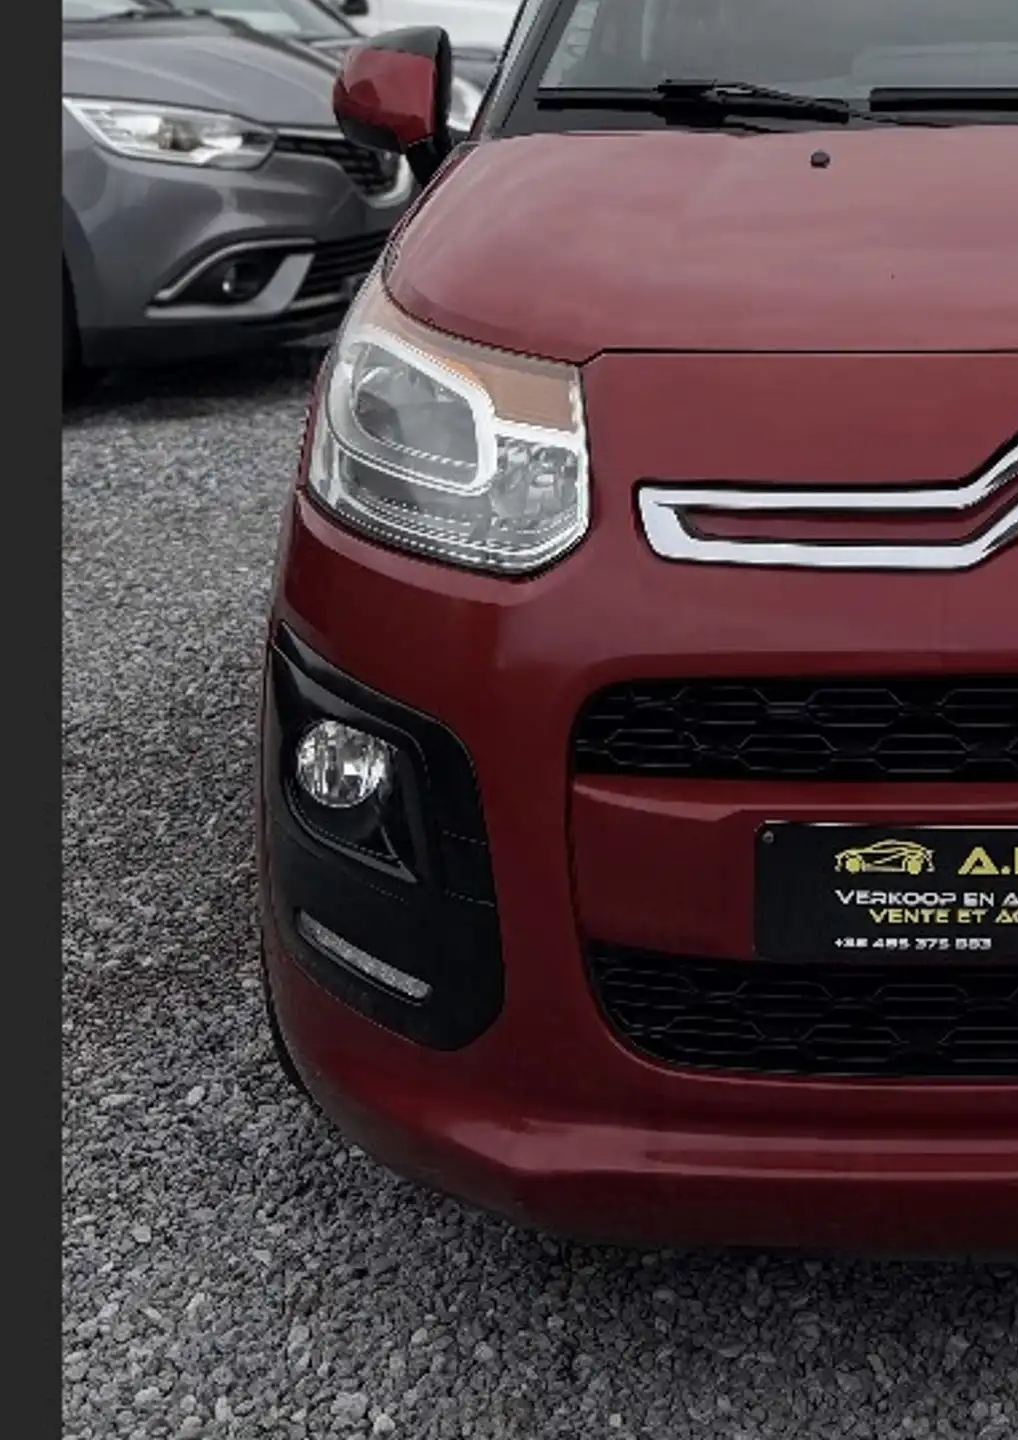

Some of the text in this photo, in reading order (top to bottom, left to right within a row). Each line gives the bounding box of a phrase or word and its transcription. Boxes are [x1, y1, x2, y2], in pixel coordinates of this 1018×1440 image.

[835, 889, 956, 907] VERKOOP
[963, 891, 995, 907] EN
[868, 908, 950, 924] VENTE
[957, 908, 988, 924] ET
